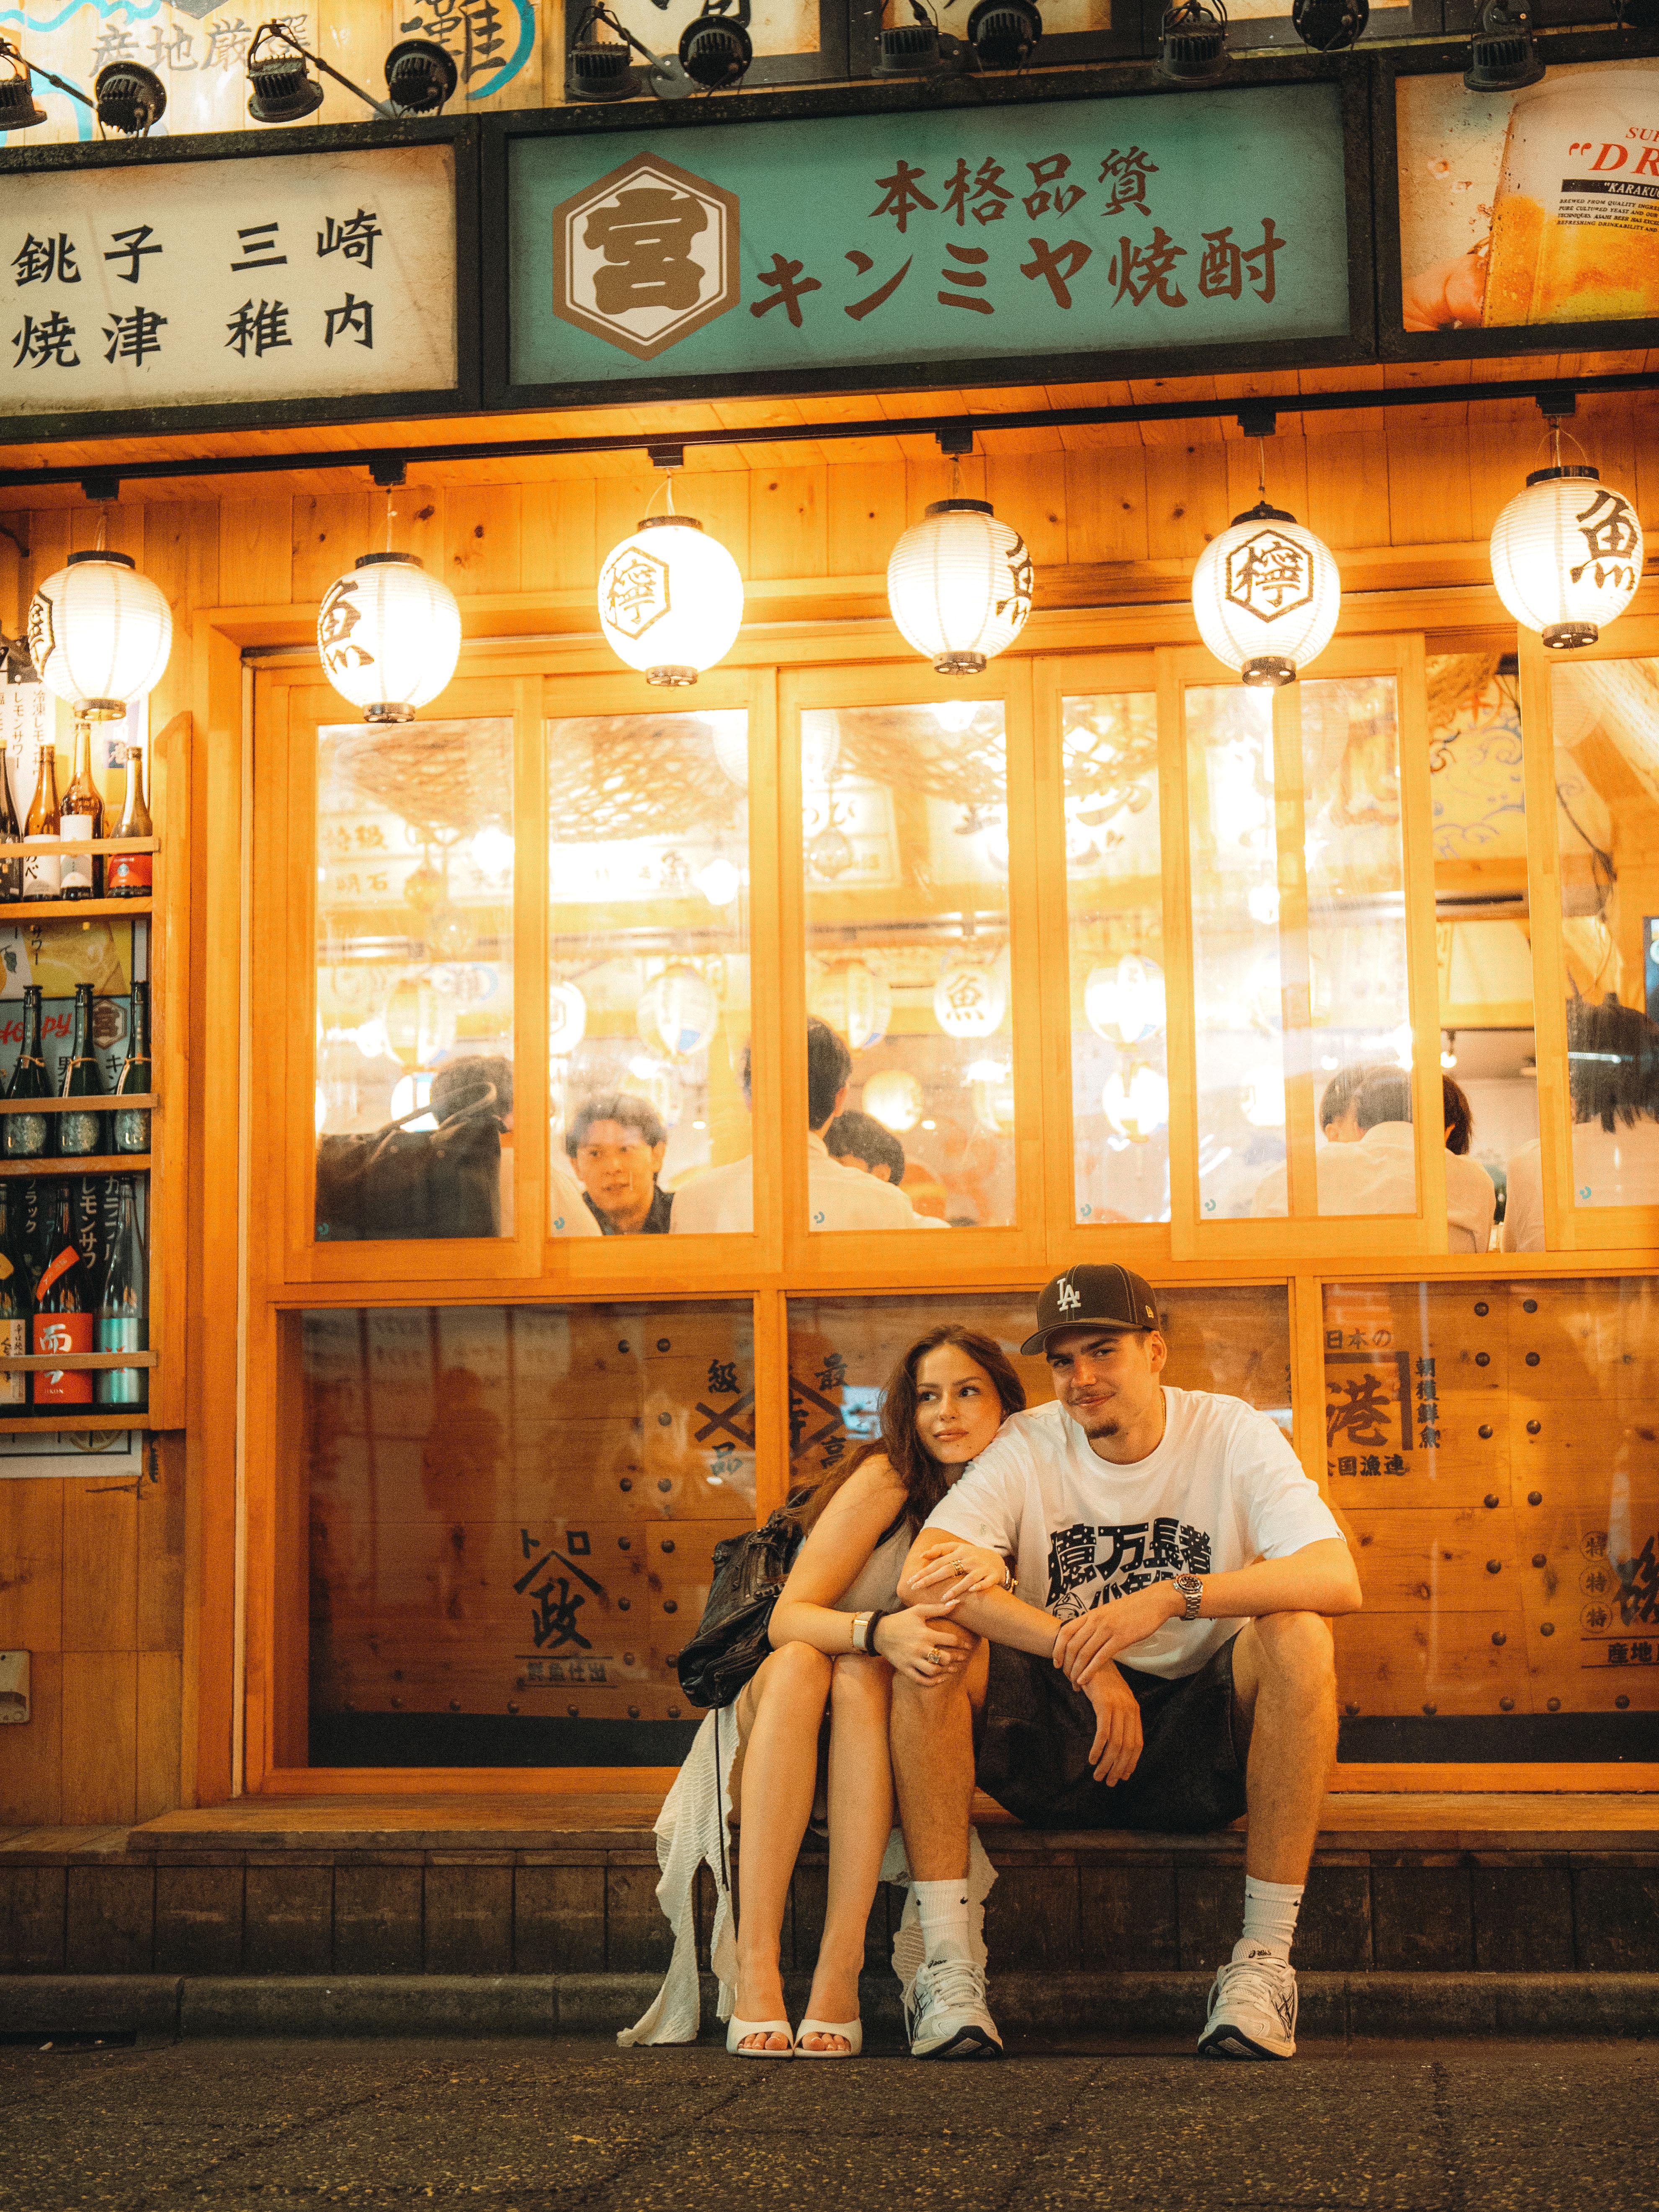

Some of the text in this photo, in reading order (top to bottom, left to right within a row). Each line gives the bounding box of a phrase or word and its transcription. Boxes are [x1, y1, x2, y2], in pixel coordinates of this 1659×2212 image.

[868, 145, 1159, 234] 本格品質
[1598, 221, 1644, 230] DRINKABILITY
[10, 208, 384, 287] 銚子 三崎
[750, 218, 1287, 328] キンミヤ焼酎
[12, 292, 374, 369] 焼津 稚内
[1570, 490, 1638, 591] 魚
[12, 691, 24, 769] レモンサワー
[945, 973, 985, 1023] 魚
[1057, 1278, 1081, 1312] LA
[1326, 1329, 1392, 1350] 日本の
[1326, 1374, 1392, 1448] 港
[520, 1529, 591, 1559] トロ
[1608, 1641, 1659, 1664] 産地
